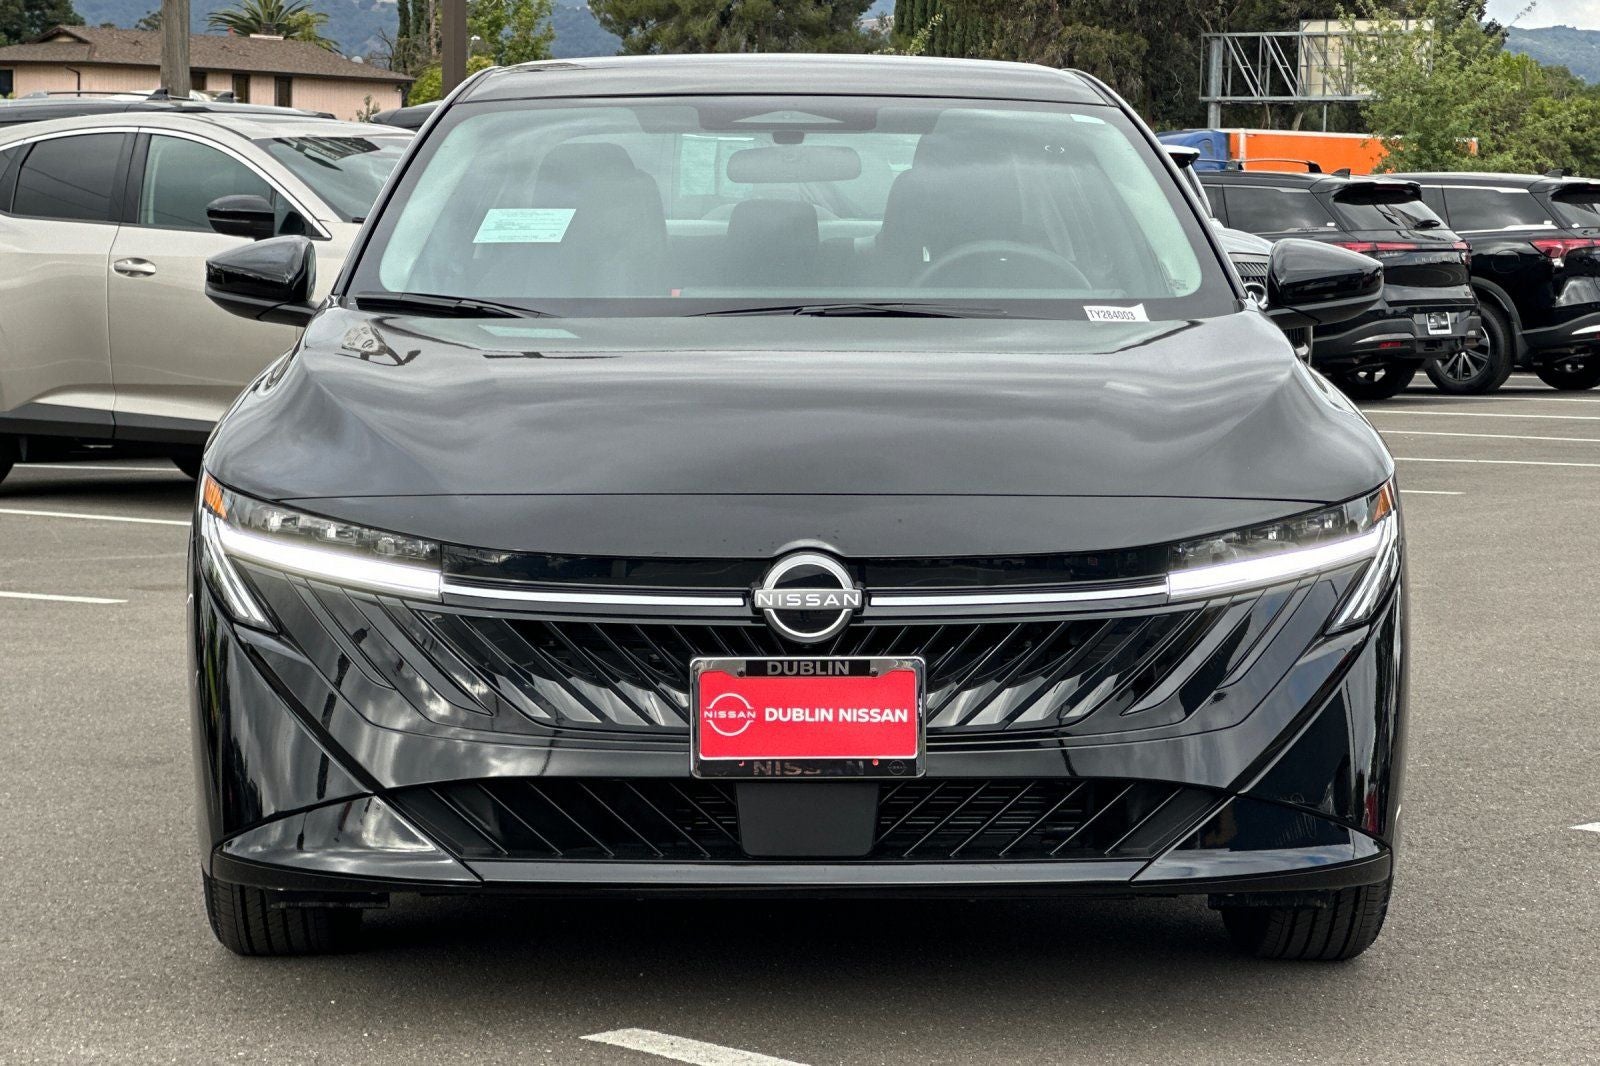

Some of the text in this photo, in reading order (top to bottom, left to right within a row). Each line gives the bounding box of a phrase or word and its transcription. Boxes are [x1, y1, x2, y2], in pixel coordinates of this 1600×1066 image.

[1088, 309, 1136, 320] TY284003
[757, 593, 859, 606] NISSAN
[767, 660, 850, 676] DUBLIN
[703, 710, 757, 719] NISSAN
[764, 707, 909, 723] DUBLIN NISSAN
[753, 760, 865, 776] NISN
